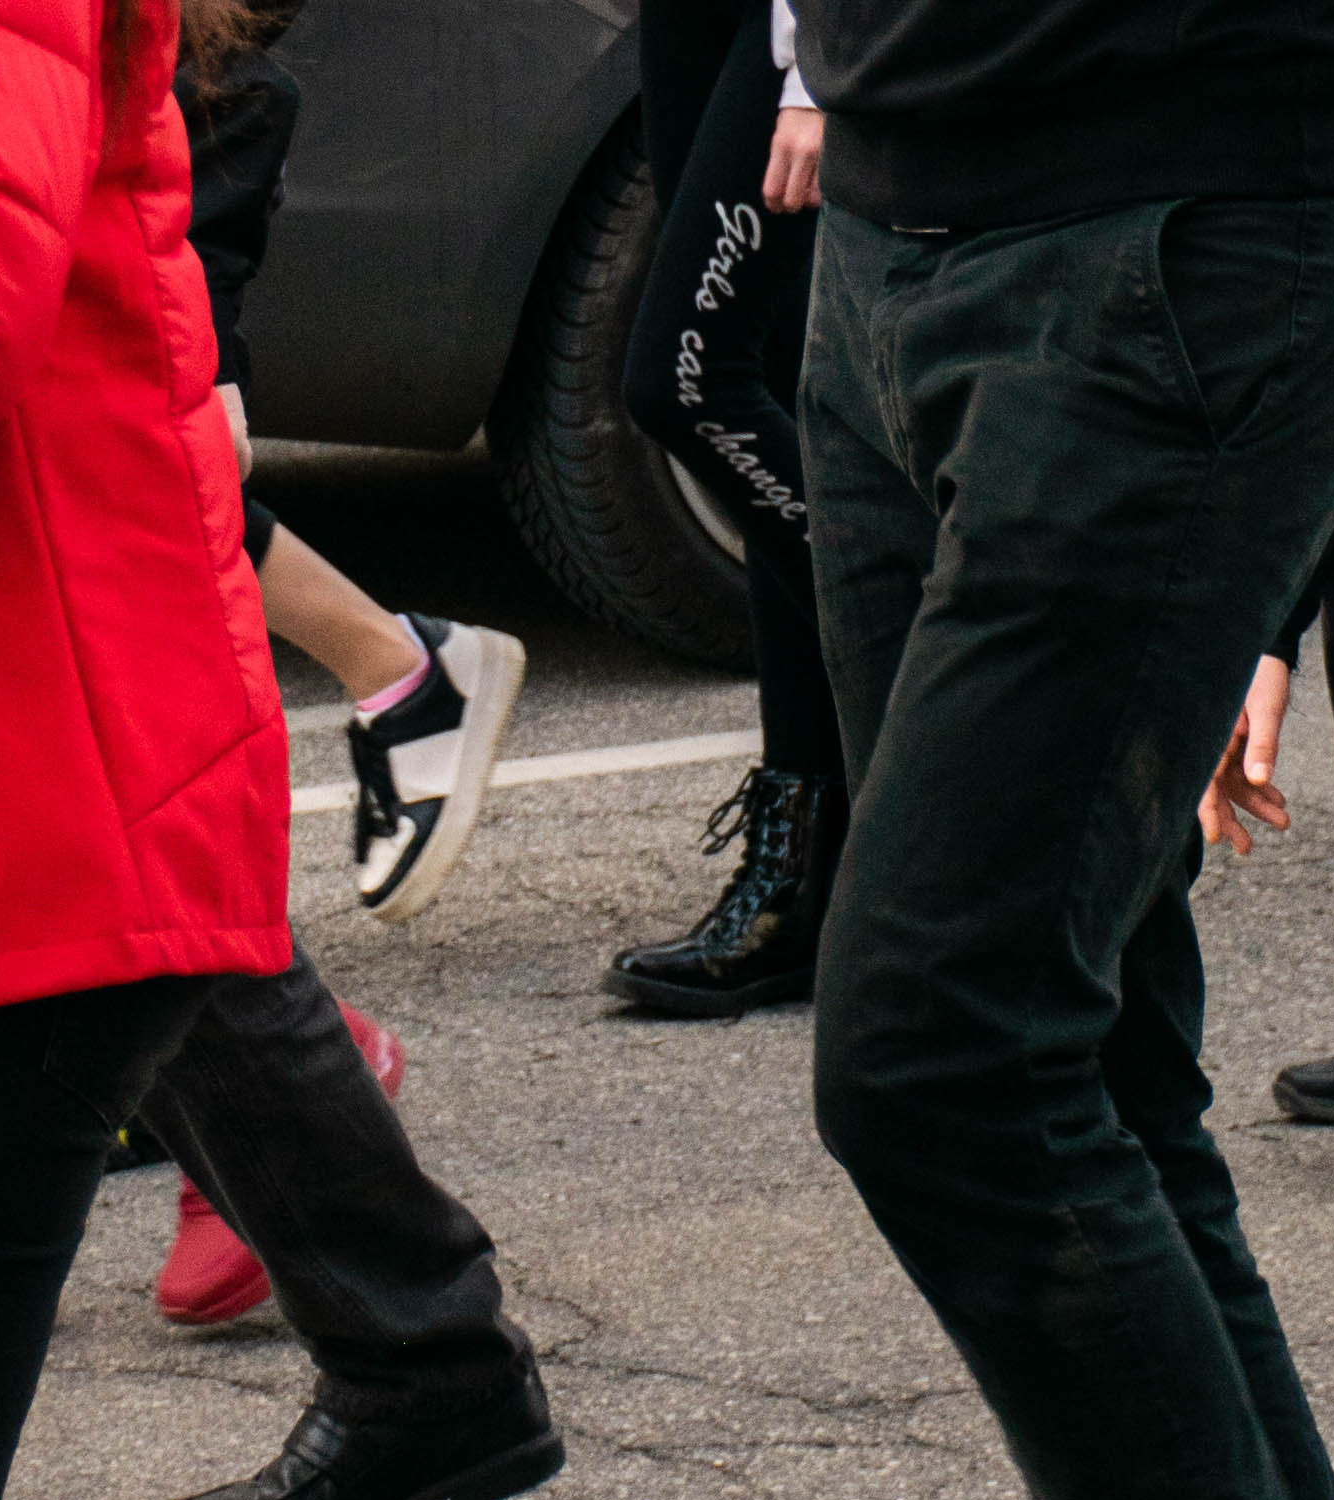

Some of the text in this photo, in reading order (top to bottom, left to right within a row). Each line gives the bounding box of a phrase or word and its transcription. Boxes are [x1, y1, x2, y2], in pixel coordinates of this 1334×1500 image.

[676, 200, 807, 520] Girls can change
